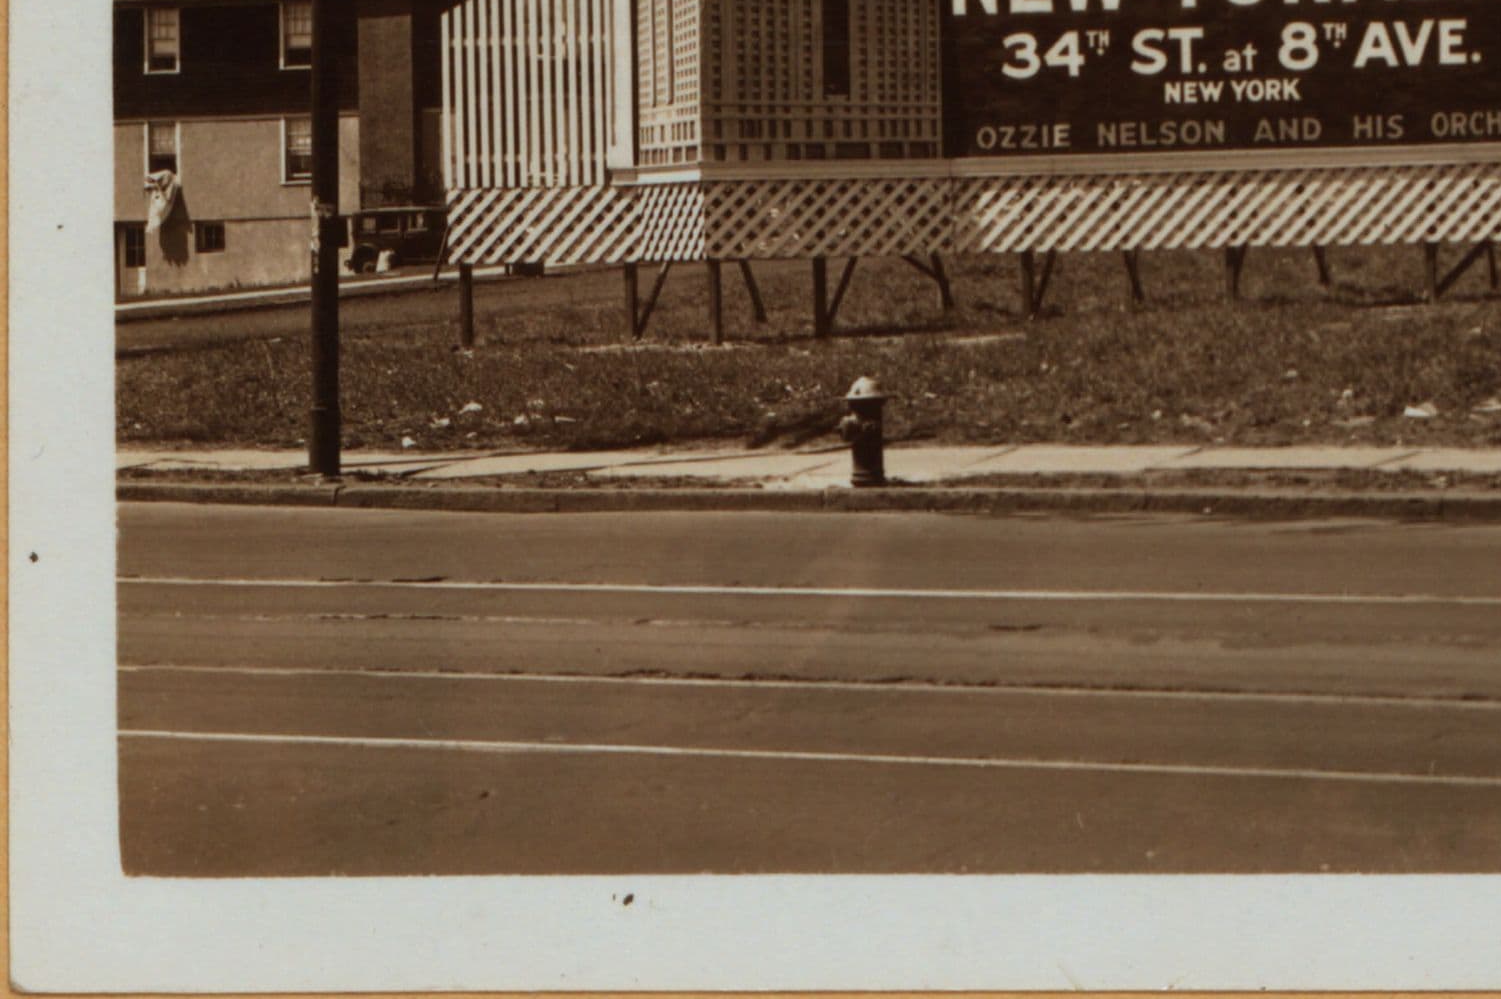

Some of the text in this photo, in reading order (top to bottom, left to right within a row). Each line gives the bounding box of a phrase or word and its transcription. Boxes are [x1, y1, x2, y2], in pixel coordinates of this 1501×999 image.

[1130, 27, 1208, 75] ST.
[1223, 43, 1258, 73] at
[1353, 18, 1482, 68] AVE.
[1164, 78, 1301, 104] NEW YORK
[976, 123, 1072, 150] OZZIE
[1097, 120, 1226, 147] NELSON
[1254, 117, 1323, 142] AND
[1353, 114, 1404, 140] HIS
